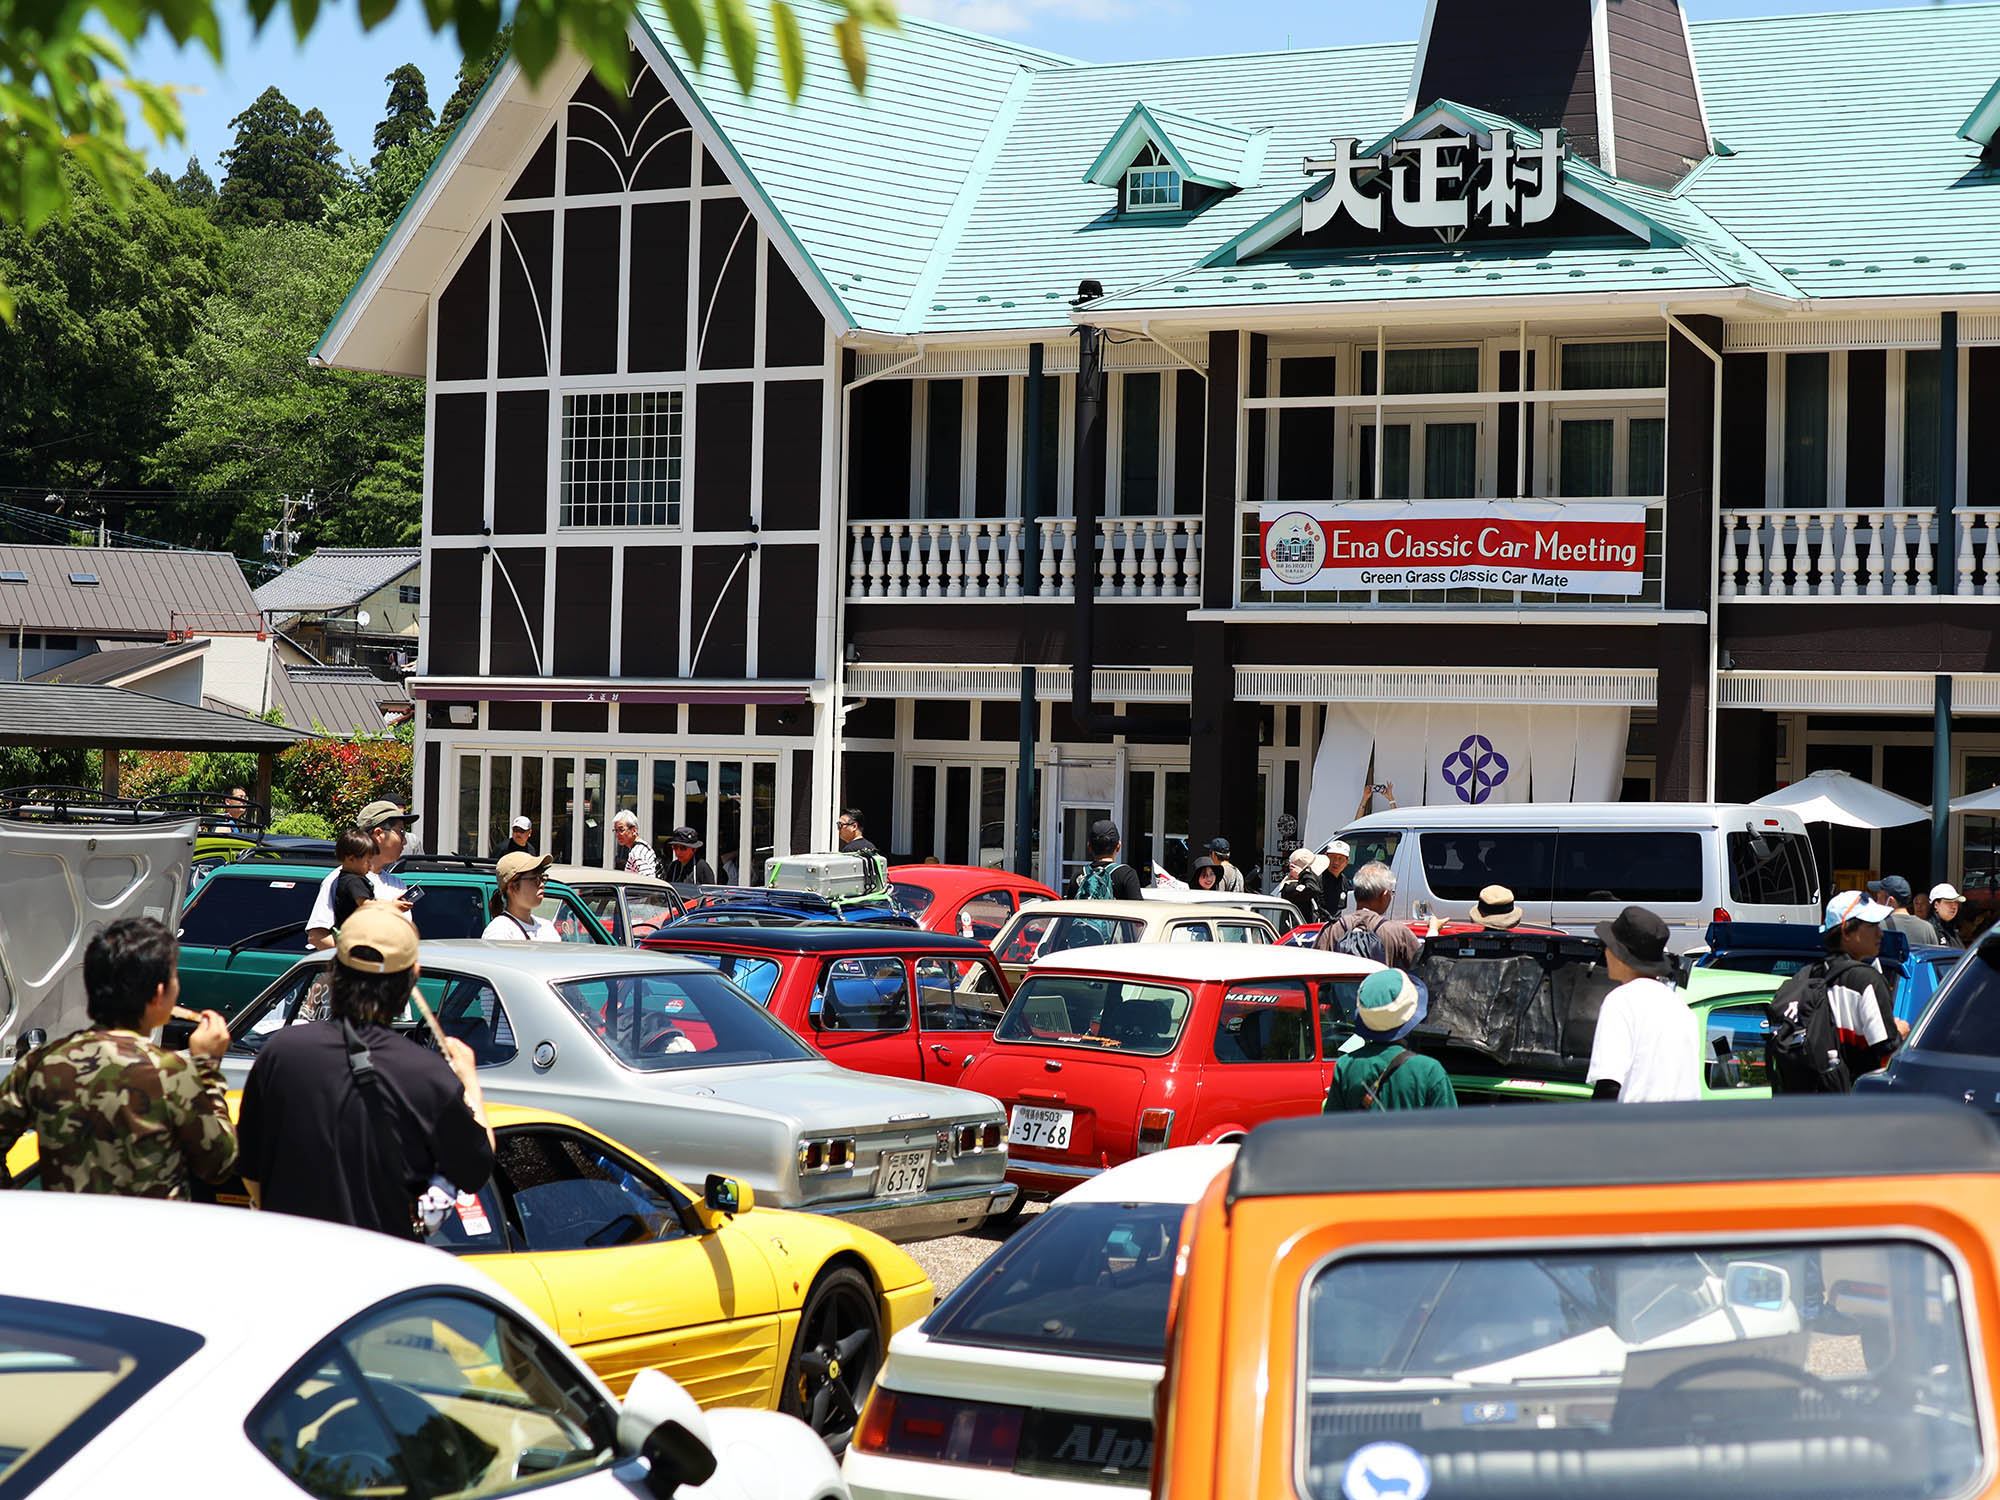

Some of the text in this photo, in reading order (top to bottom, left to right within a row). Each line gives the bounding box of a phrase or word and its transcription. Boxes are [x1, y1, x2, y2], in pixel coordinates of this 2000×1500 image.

[1302, 127, 1565, 236] 大正村
[1332, 527, 1637, 566] Ena Classic Car Meeting
[1361, 570, 1568, 587] Green Grass Classic Car Mate
[1225, 993, 1279, 1004] MARTINI
[1022, 1121, 1067, 1145] 97-68
[888, 1167, 925, 1192] 63-79
